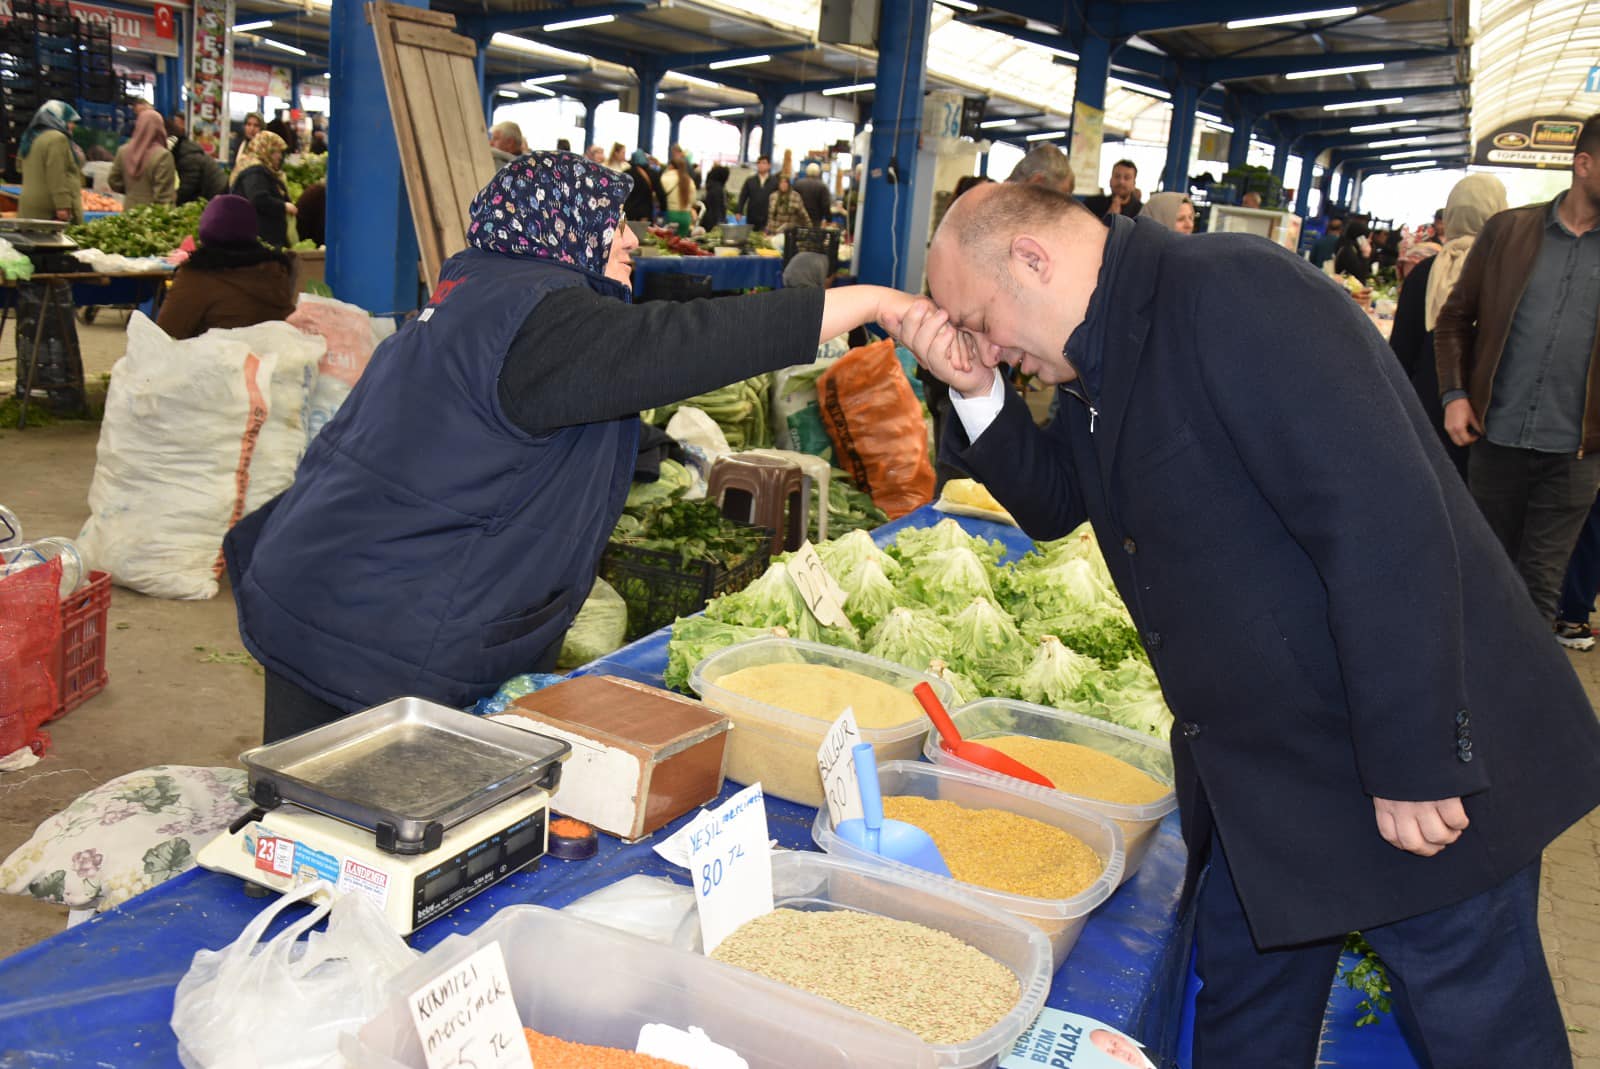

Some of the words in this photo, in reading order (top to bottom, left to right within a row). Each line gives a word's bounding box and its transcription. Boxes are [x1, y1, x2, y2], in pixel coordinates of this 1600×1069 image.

[257, 838, 275, 861] 23
[702, 858, 722, 897] 80
[1028, 1027, 1057, 1064] BİZİM
[1049, 1022, 1085, 1069] PALAZ
